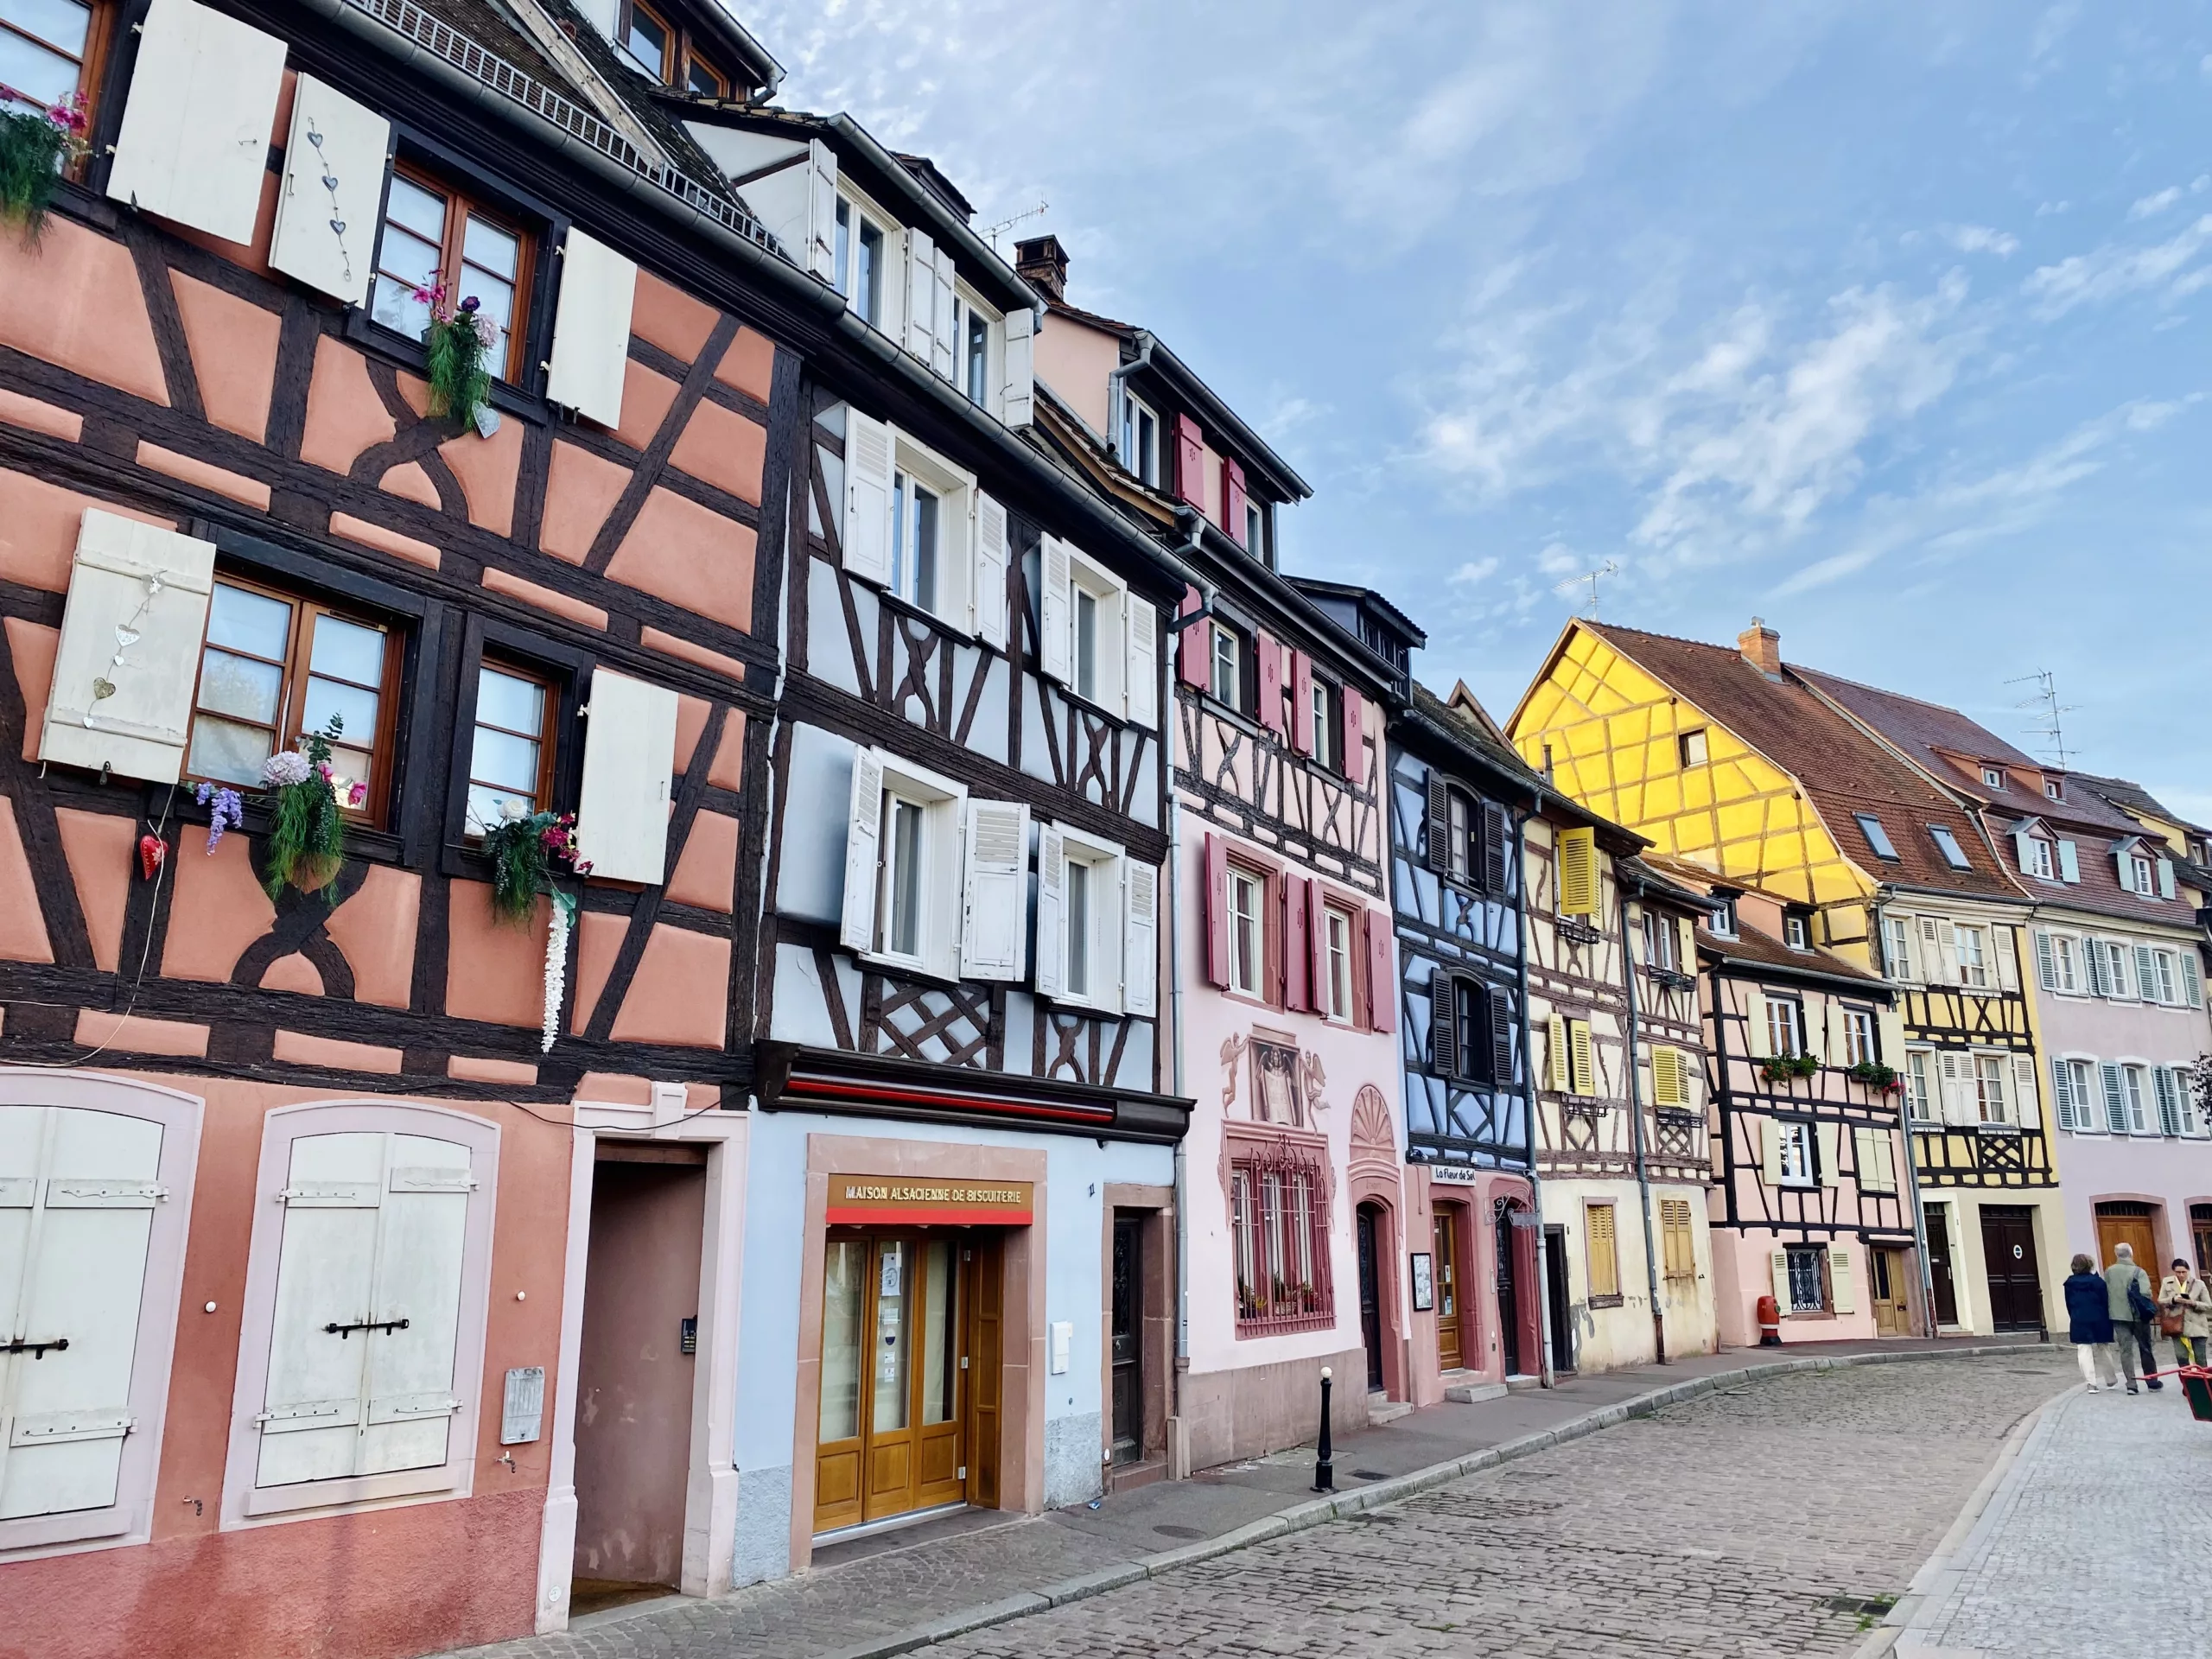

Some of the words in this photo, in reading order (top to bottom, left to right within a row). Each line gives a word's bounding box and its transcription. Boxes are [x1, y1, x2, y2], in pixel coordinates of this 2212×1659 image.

[1459, 1169, 1465, 1180] de
[1466, 1170, 1476, 1180] Sel
[846, 1185, 887, 1199] MAISON
[891, 1187, 950, 1201] ALSACIENNE
[952, 1189, 965, 1202] DE
[967, 1189, 1021, 1203] BISCUITERIE
